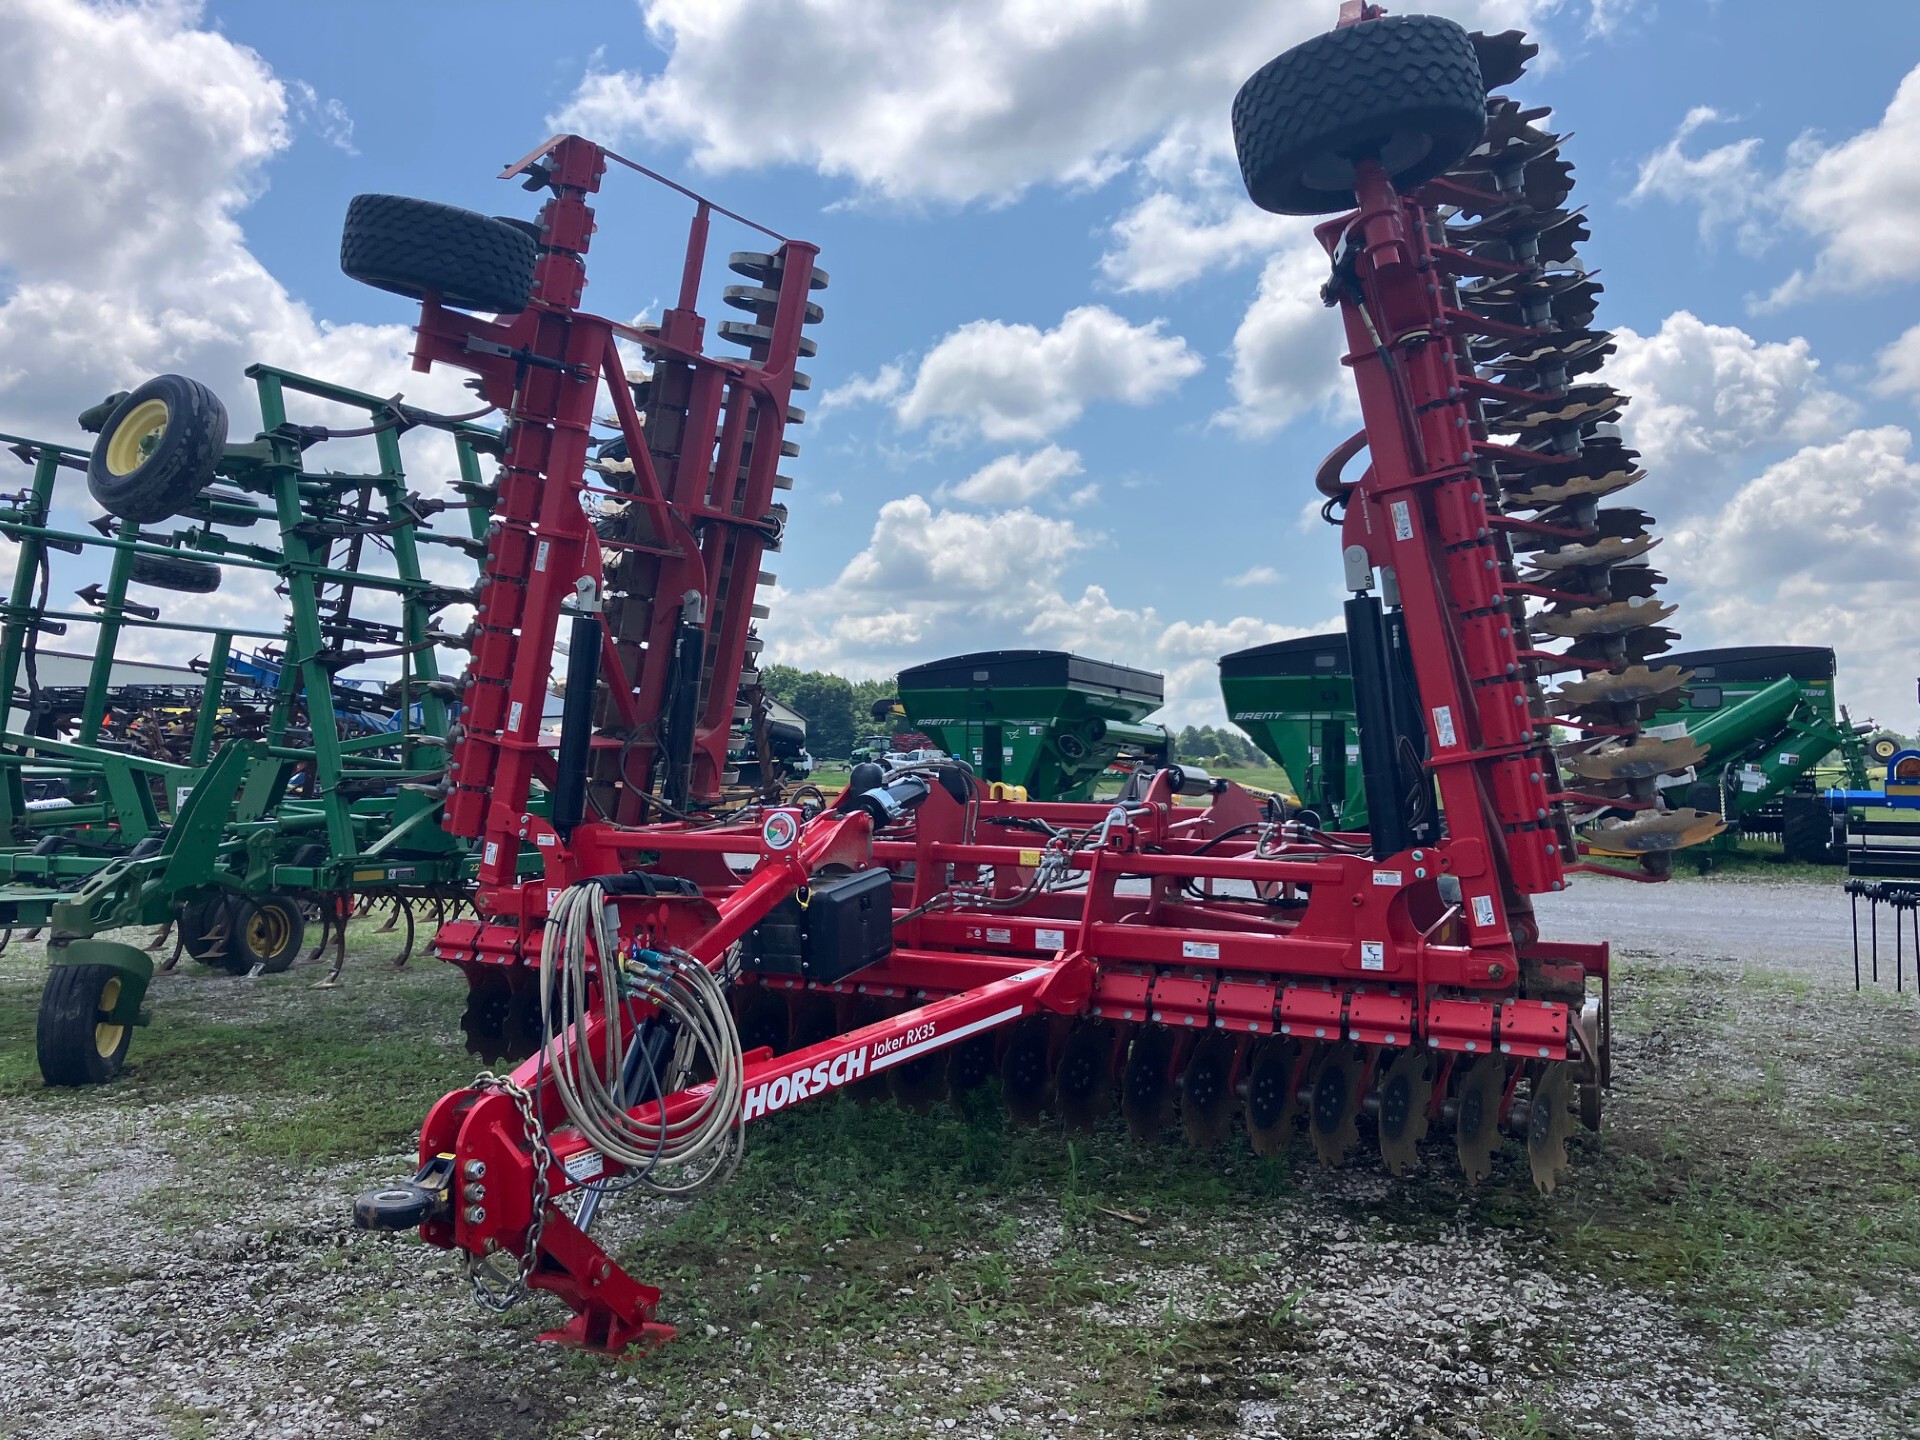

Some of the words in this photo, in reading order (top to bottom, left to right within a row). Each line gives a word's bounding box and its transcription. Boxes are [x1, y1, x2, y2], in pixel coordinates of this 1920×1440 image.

[1234, 712, 1283, 720] BRENT
[916, 718, 955, 726] BRENT
[744, 1046, 867, 1122] HORSCH
[872, 1036, 904, 1058] Joker
[906, 1021, 936, 1045] RX35
